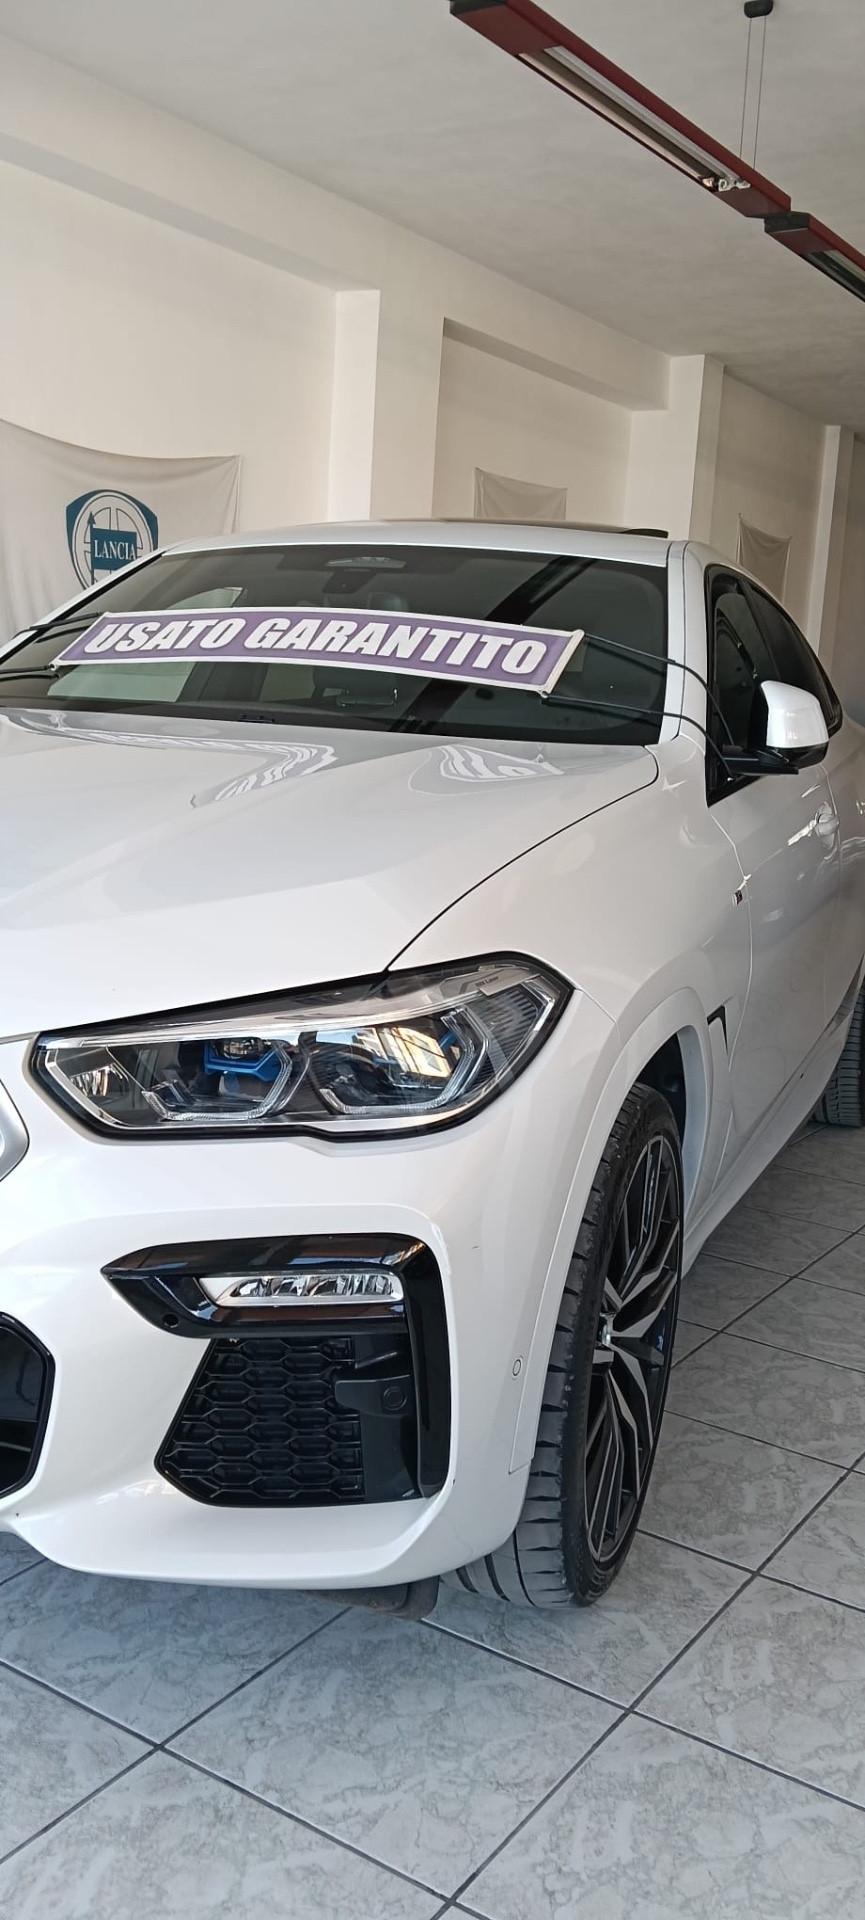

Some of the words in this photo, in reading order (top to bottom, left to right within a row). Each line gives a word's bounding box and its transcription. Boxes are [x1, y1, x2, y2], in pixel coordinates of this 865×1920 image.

[94, 540, 137, 560] LANCIA
[84, 618, 246, 654] USATO
[244, 618, 547, 674] GARANTITO
